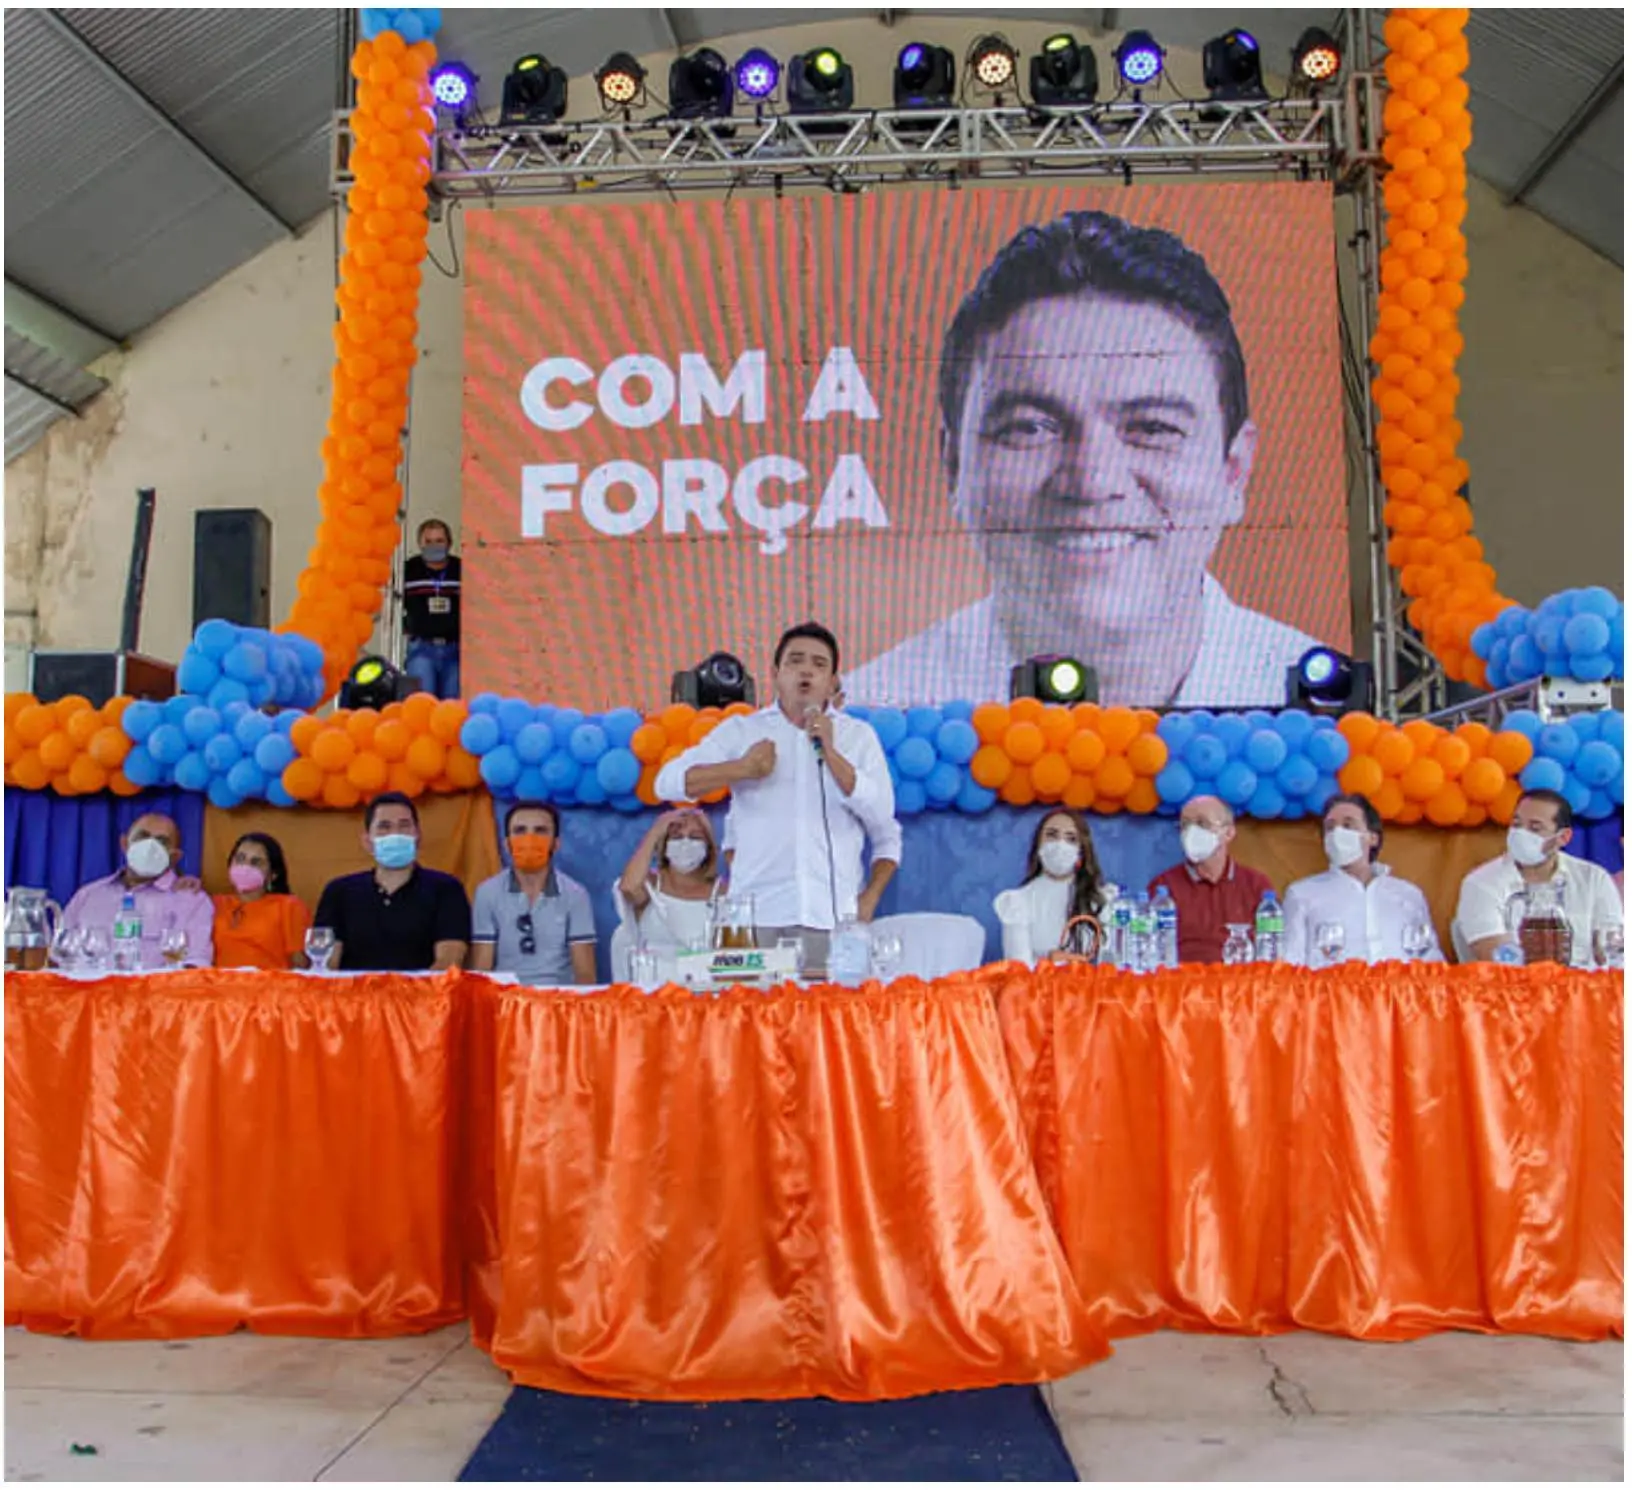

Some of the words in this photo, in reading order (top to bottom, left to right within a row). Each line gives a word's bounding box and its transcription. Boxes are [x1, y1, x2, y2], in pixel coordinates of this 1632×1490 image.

[520, 348, 767, 432] COM
[801, 346, 881, 422] A
[520, 453, 890, 556] FORÇA
